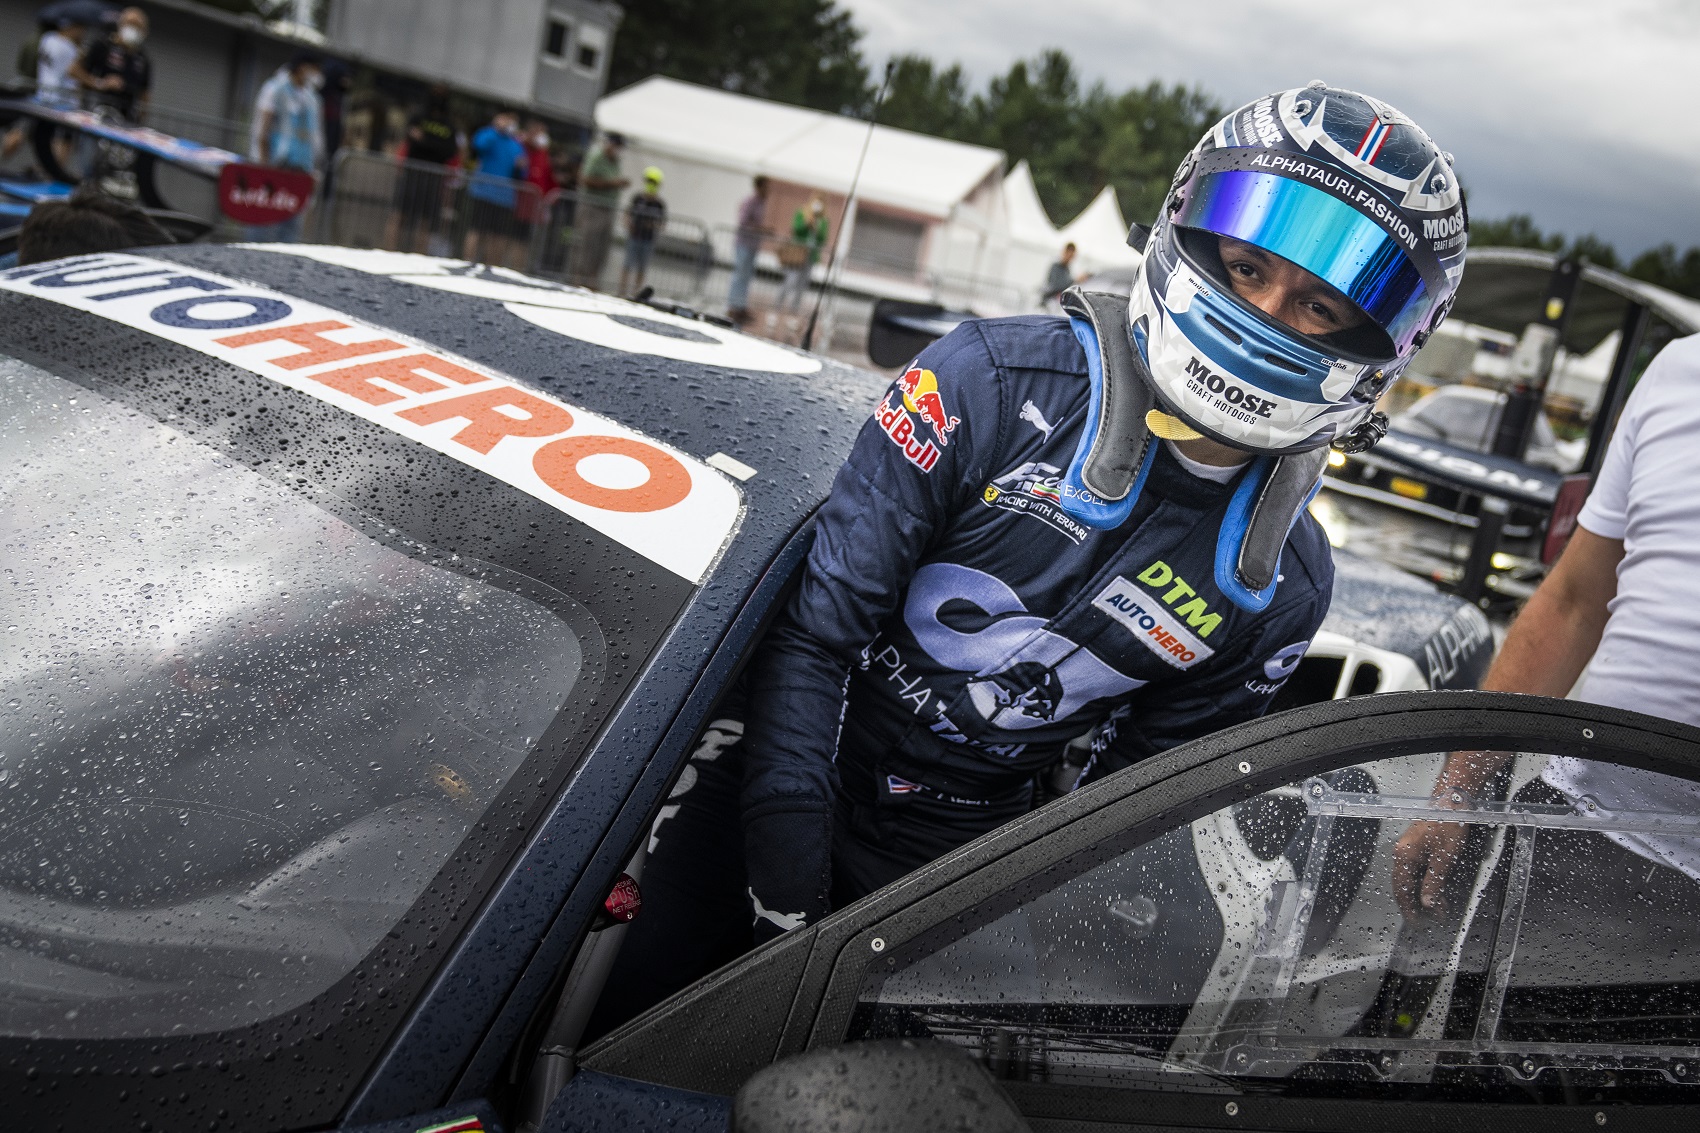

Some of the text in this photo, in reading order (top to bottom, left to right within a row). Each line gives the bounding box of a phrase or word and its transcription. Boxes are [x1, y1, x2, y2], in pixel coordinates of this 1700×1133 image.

[1250, 154, 1419, 250] ALPHATAURI.FASHION
[1184, 356, 1278, 419] MOOSE
[1186, 379, 1257, 425] CRAFT HOTDOGS
[889, 413, 941, 473] Bull
[1028, 501, 1053, 517] WITH
[1052, 511, 1088, 541] FERRARI
[1106, 593, 1196, 663] AUTOHERO
[1136, 560, 1223, 638] DTM
[610, 884, 640, 907] PUSH
[612, 904, 625, 914] NET
